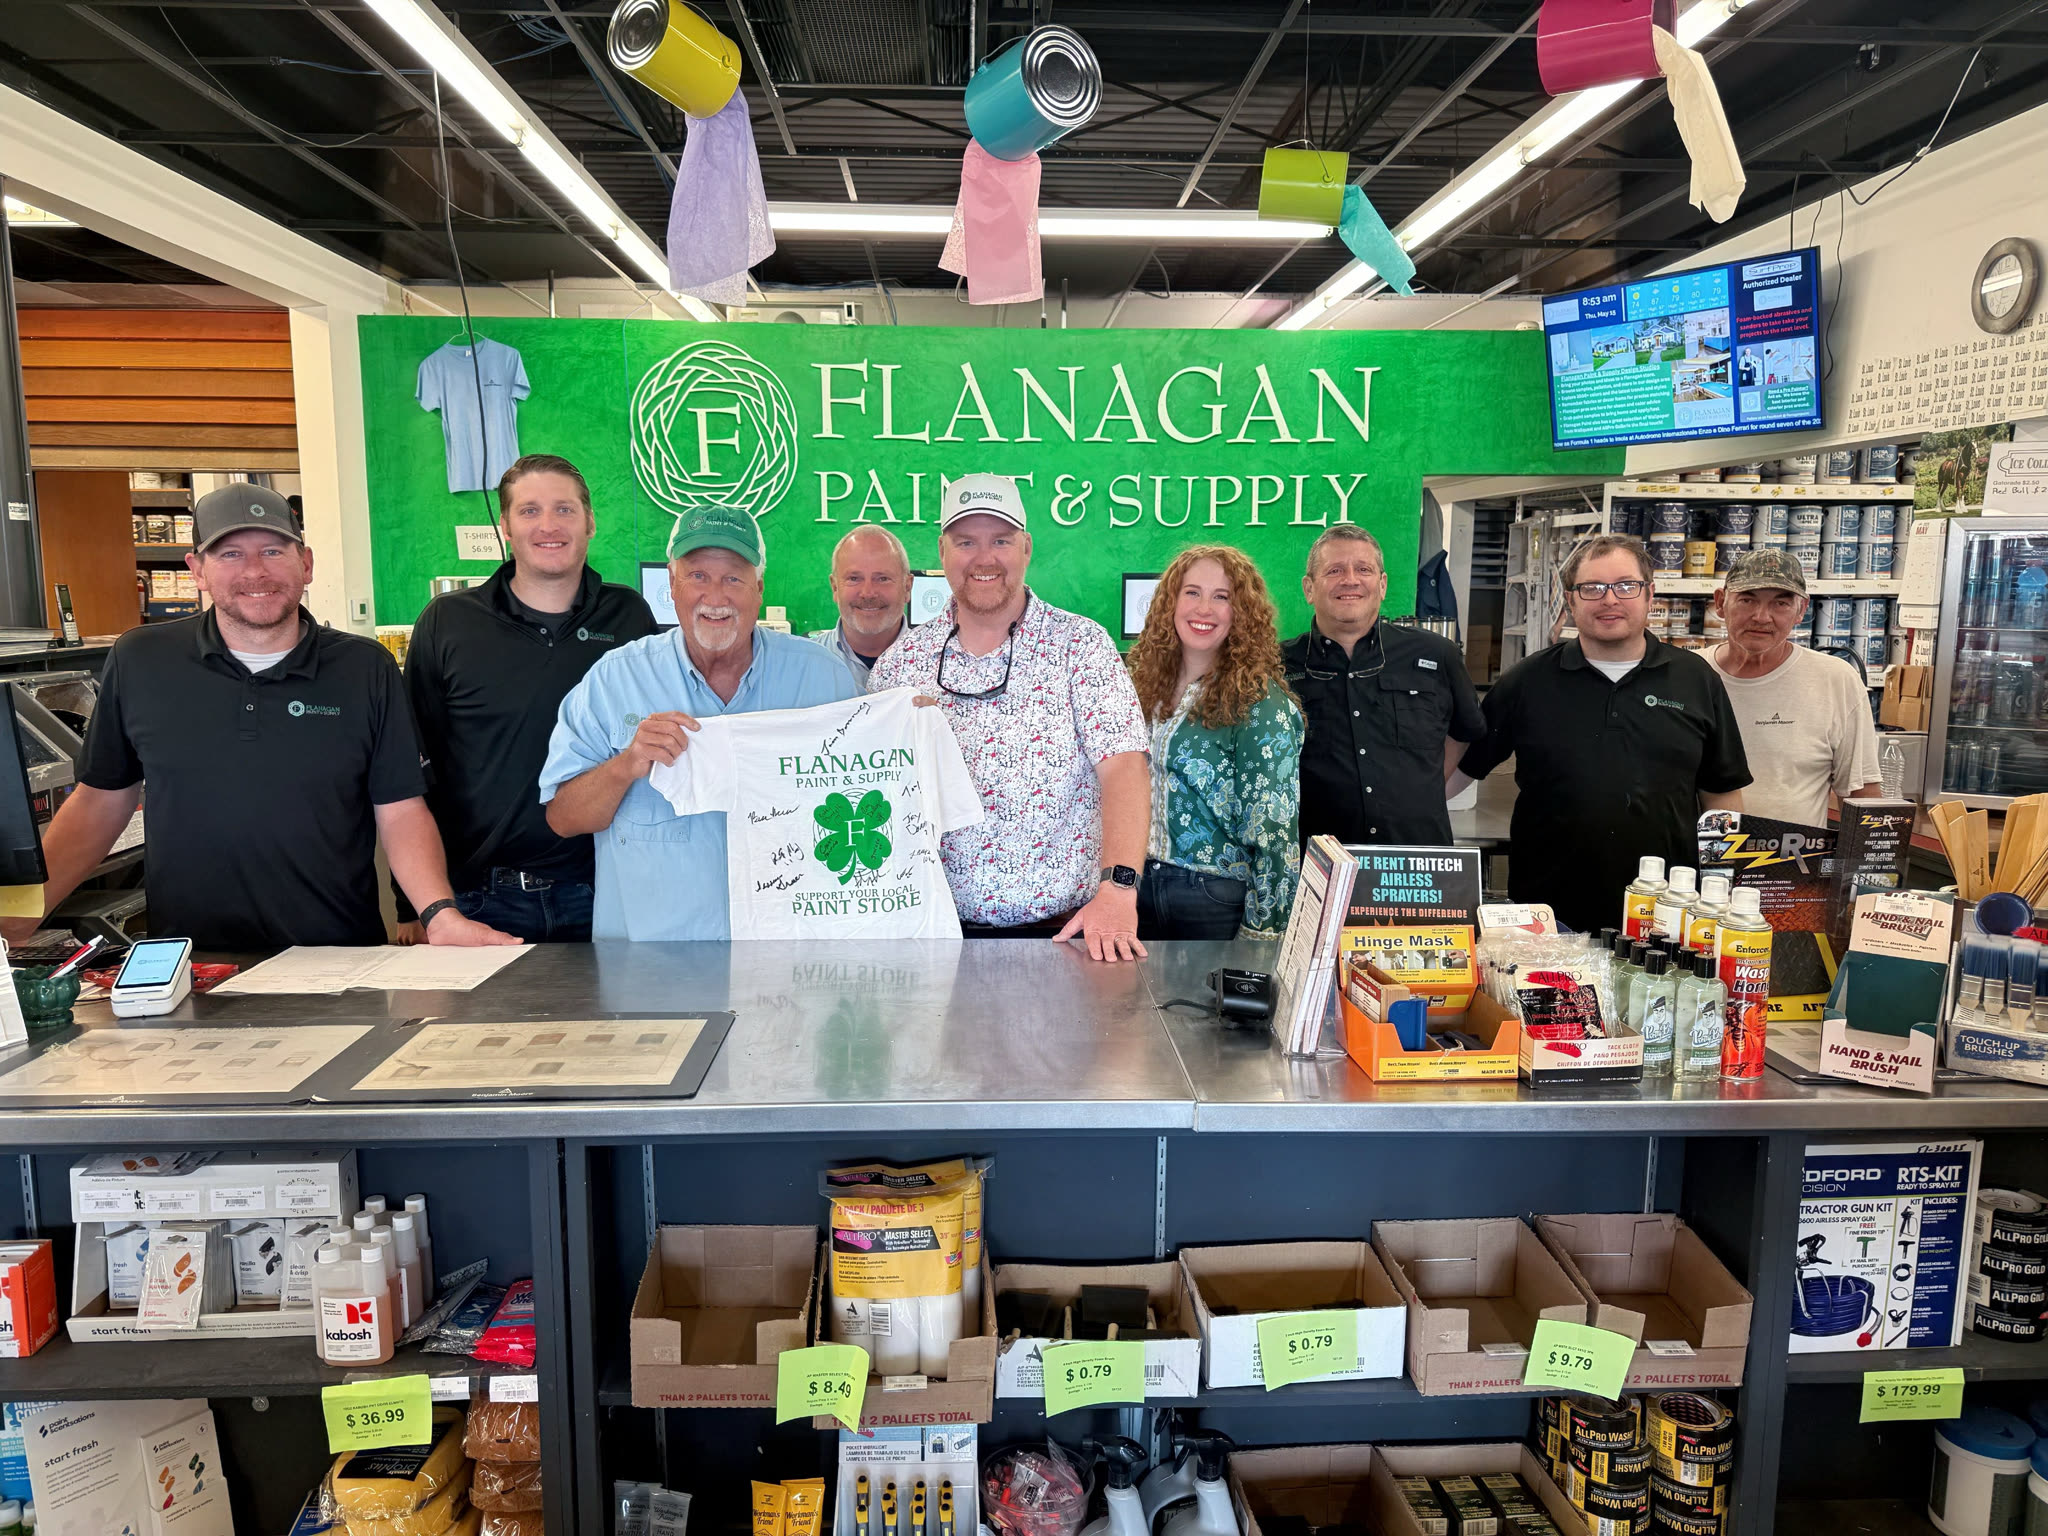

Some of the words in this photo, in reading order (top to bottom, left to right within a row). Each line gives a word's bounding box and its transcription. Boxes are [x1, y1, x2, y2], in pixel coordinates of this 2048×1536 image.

[1743, 278, 1778, 289] Authorized
[1780, 274, 1802, 283] Dealer
[1582, 297, 1600, 306] 8:53
[1602, 294, 1616, 302] am
[1774, 309, 1800, 317] abrasives
[1740, 321, 1761, 330] sanders
[1740, 330, 1762, 339] projects
[811, 358, 1381, 444] FLANAGAN
[687, 402, 741, 477] F
[2010, 458, 2024, 469] ICE
[814, 468, 1033, 524] PAI
[1050, 474, 1093, 526] &
[1109, 472, 1368, 528] SUPPLY
[464, 532, 498, 540] T-SHIRTS
[1916, 526, 1928, 535] MAY
[306, 704, 341, 712] FLANAGAN
[778, 748, 914, 775] FLANAGAN
[796, 777, 838, 788] PAINT
[843, 776, 853, 785] &
[858, 771, 901, 784] SUPPLY
[1883, 815, 1904, 830] RUST
[844, 818, 866, 847] F
[1373, 856, 1405, 871] RENT
[1408, 857, 1463, 872] TRITECH
[1380, 872, 1433, 887] AIRLESS
[795, 891, 844, 901] SUPPORT
[849, 889, 879, 898] YOUR
[882, 884, 915, 897] LOCAL
[1372, 888, 1442, 903] SPRAYERS!
[792, 900, 851, 916] PAINT
[858, 891, 921, 914] STORE
[1351, 906, 1399, 916] EXPERIENCE
[1401, 908, 1416, 917] THE
[1419, 909, 1468, 918] DIFFERENCE
[1861, 912, 1898, 921] HAND
[1914, 918, 1945, 928] NAIL
[1880, 922, 1924, 934] BRUSH
[1354, 936, 1403, 949] Hinge
[1410, 935, 1454, 946] Mask
[1736, 965, 1769, 980] Wasp
[1960, 1034, 2020, 1050] TOUCH-UP
[1828, 1043, 1870, 1060] HAND
[1877, 1052, 1886, 1061] &
[1888, 1053, 1923, 1067] NAIL
[1964, 1044, 2014, 1058] BRUSHES
[1849, 1059, 1900, 1075] BRUSH
[1802, 1168, 1881, 1182] DFORD
[1898, 1165, 1962, 1183] RTS-KIT
[837, 1206, 842, 1215] 3
[844, 1205, 865, 1215] PACK
[867, 1205, 870, 1214] /
[871, 1204, 906, 1214] PAQUETE
[907, 1204, 917, 1213] DE
[919, 1203, 924, 1212] 3
[1851, 1203, 1874, 1213] GUN
[1876, 1203, 1893, 1212] KIT
[885, 1231, 909, 1240] MASTER
[910, 1230, 932, 1238] SELECT
[2024, 1265, 2045, 1274] GOLD
[2030, 1292, 2045, 1303] GOLD
[91, 1327, 118, 1335] start
[121, 1326, 151, 1335] fresh
[326, 1328, 372, 1342] kabosh
[2013, 1324, 2035, 1334] GOLD
[1288, 1340, 1297, 1354] $
[1301, 1334, 1333, 1350] 0.79
[1548, 1351, 1557, 1366] $
[1559, 1353, 1593, 1371] 9.79
[1066, 1369, 1075, 1383] $
[1079, 1364, 1112, 1379] 0.79
[1633, 1374, 1642, 1384] 2
[1645, 1374, 1695, 1384] PALLETS
[1698, 1373, 1732, 1383] TOTAL
[809, 1381, 818, 1396] $
[823, 1381, 852, 1399] 8.49
[1448, 1381, 1473, 1389] THAN
[1474, 1380, 1481, 1388] 2
[1483, 1379, 1521, 1388] PALLETS
[1877, 1385, 1886, 1398] $
[1892, 1384, 1941, 1397] 179.99
[49, 1417, 68, 1429] paint
[50, 1412, 95, 1434] scentsations
[346, 1413, 356, 1429] $
[361, 1408, 405, 1425] 36.99
[44, 1453, 70, 1468] start
[73, 1440, 99, 1455] fresh
[1615, 1462, 1642, 1473] WASHI
[786, 1508, 818, 1519] Workman's
[757, 1518, 774, 1526] Friend
[791, 1518, 811, 1527] Friend
